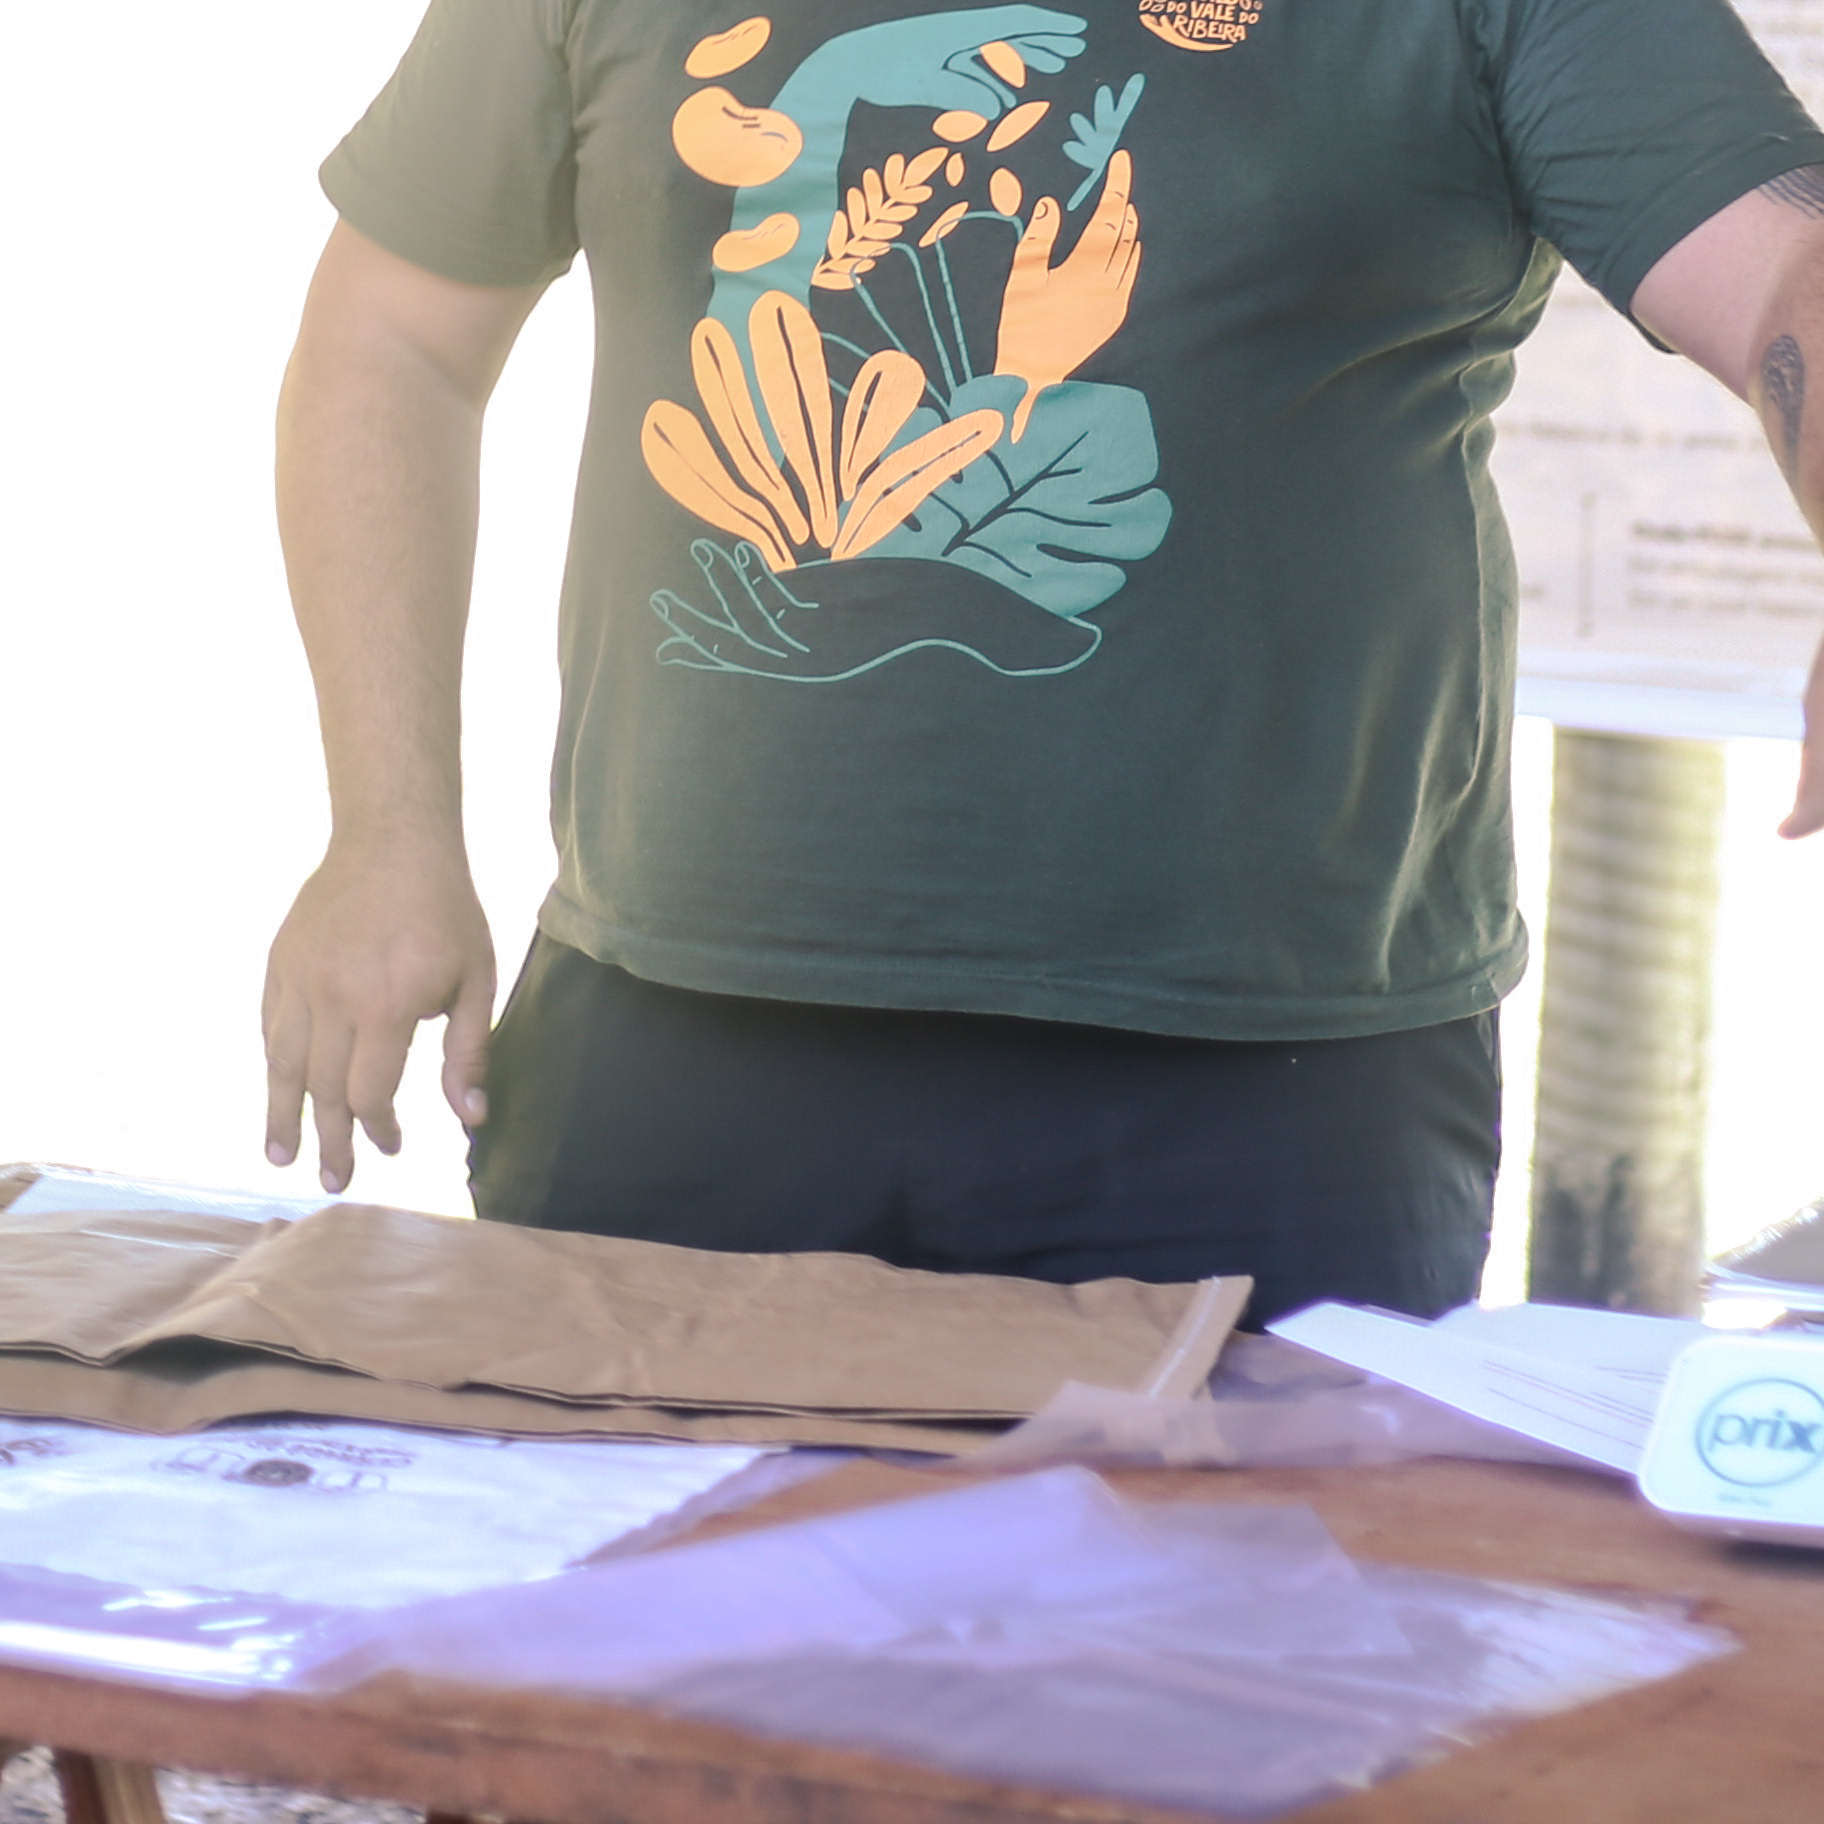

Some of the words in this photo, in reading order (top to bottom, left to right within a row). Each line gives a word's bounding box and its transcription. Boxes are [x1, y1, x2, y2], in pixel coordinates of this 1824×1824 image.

[1167, 1, 1187, 14] DO
[1190, 1, 1235, 21] VALE
[1239, 11, 1259, 24] DO
[1173, 14, 1246, 43] RIBEIRA
[1707, 1409, 1824, 1454] prix
